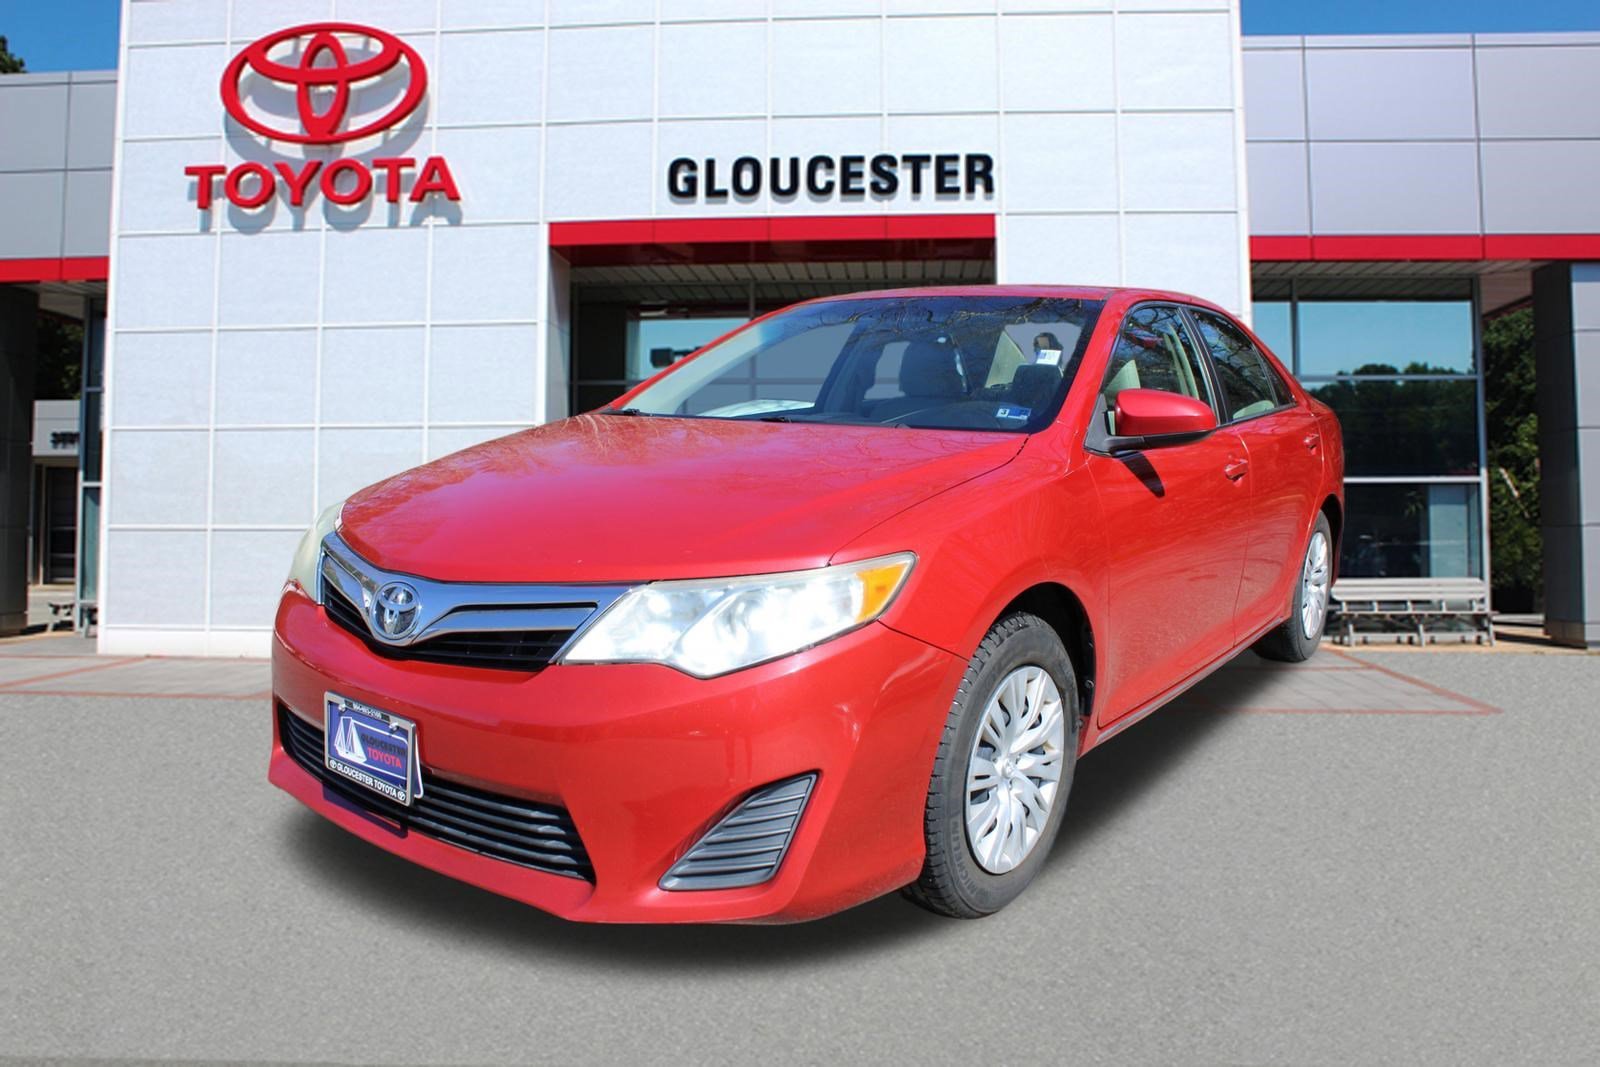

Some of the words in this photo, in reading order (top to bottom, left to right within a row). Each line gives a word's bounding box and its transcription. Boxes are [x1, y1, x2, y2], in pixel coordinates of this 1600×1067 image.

[185, 156, 460, 209] TOYOTA
[668, 154, 994, 200] GLOUCESTER
[367, 747, 402, 769] TOYOTA
[337, 763, 374, 786] GLOUCESTER
[374, 779, 397, 798] TOYOTA
